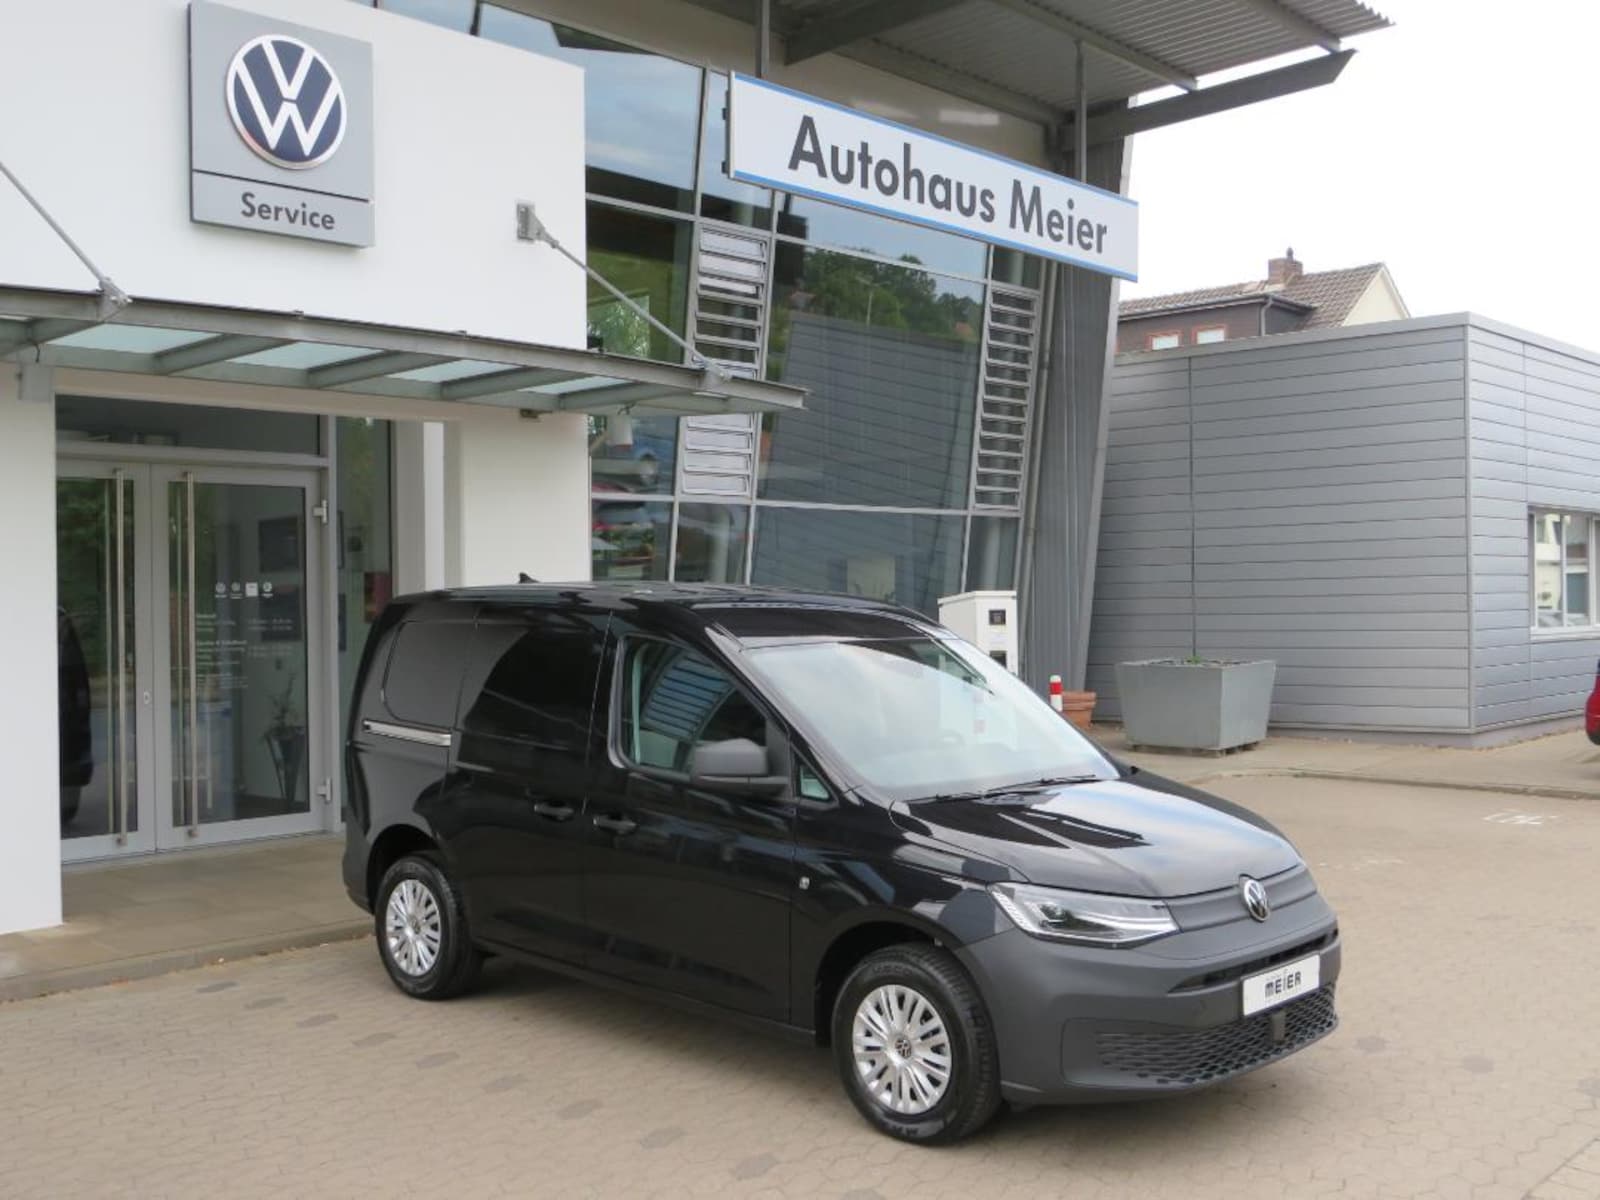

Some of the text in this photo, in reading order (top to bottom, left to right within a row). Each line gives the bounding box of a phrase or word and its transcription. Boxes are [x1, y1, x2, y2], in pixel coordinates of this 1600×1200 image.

[231, 37, 342, 160] VW
[240, 191, 335, 231] Service
[788, 114, 1108, 255] Autohaus Meier
